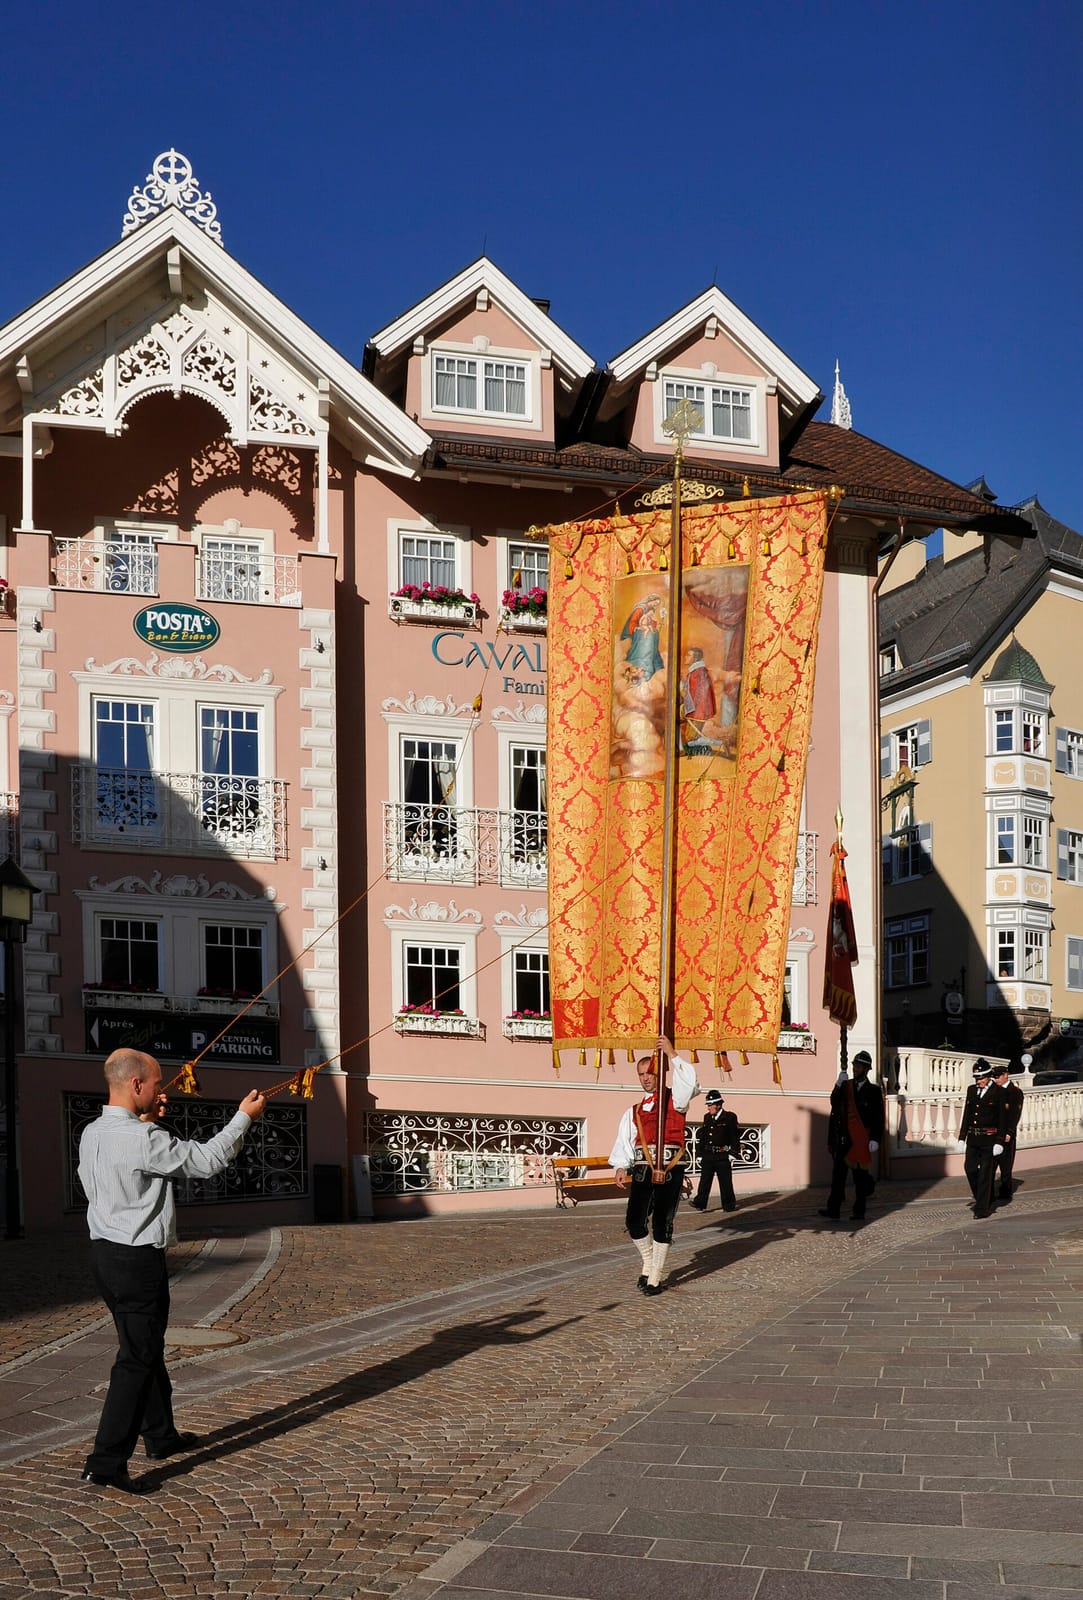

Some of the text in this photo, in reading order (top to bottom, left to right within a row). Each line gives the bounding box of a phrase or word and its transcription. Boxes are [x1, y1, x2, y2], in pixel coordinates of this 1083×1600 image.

[147, 631, 169, 641] Bar
[169, 631, 179, 641] &
[431, 631, 547, 673] CAVAL
[503, 676, 547, 696] Fami
[154, 1041, 172, 1050] Ski
[191, 1031, 206, 1050] P
[221, 1035, 262, 1044] CENTRAL
[211, 1043, 273, 1056] PARKING
